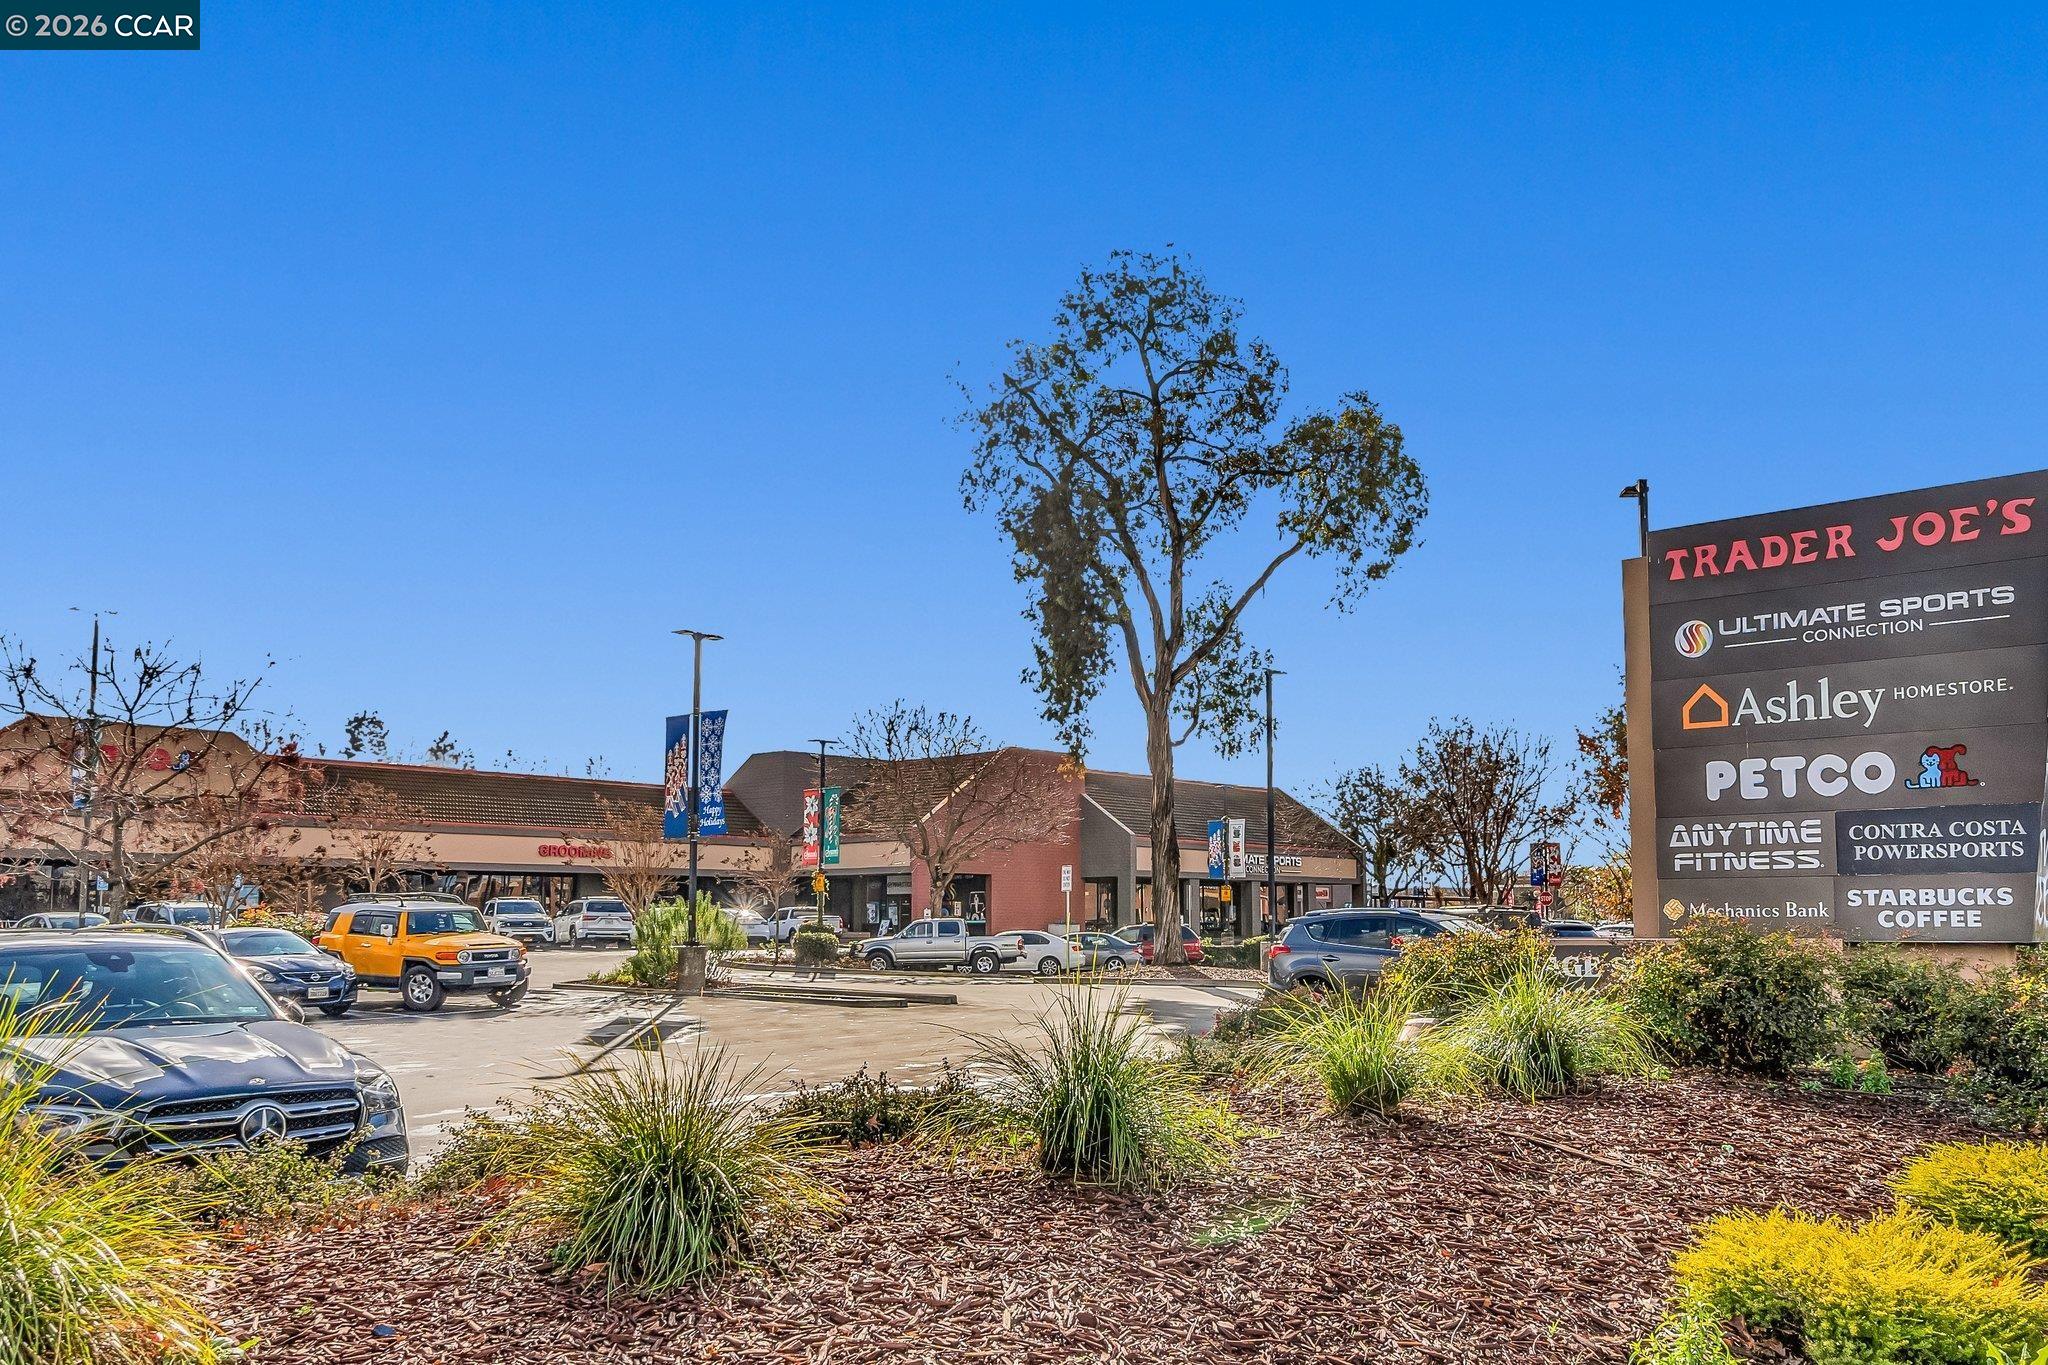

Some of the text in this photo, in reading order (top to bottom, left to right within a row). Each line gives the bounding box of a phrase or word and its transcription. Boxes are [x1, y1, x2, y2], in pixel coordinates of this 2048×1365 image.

[1665, 497, 2036, 581] TRADER JOE'S
[1718, 585, 2016, 636] ULTIMATE SPORTS
[1802, 618, 1924, 644] CONNECTION
[1732, 676, 1886, 728] Ashley
[1705, 751, 1896, 801] PETCO
[702, 805, 722, 817] Happy
[700, 817, 725, 829] Holidays
[1669, 819, 1822, 848] ANYTIME
[1848, 819, 2028, 841] CONTRA COSTA
[1267, 855, 1302, 867] PORTS
[1853, 840, 2025, 861] POWERSPORTS
[1847, 887, 2014, 907] STARBUCKS
[1689, 901, 1830, 919] Mechanics Bank
[1877, 909, 1983, 929] COFFEE
